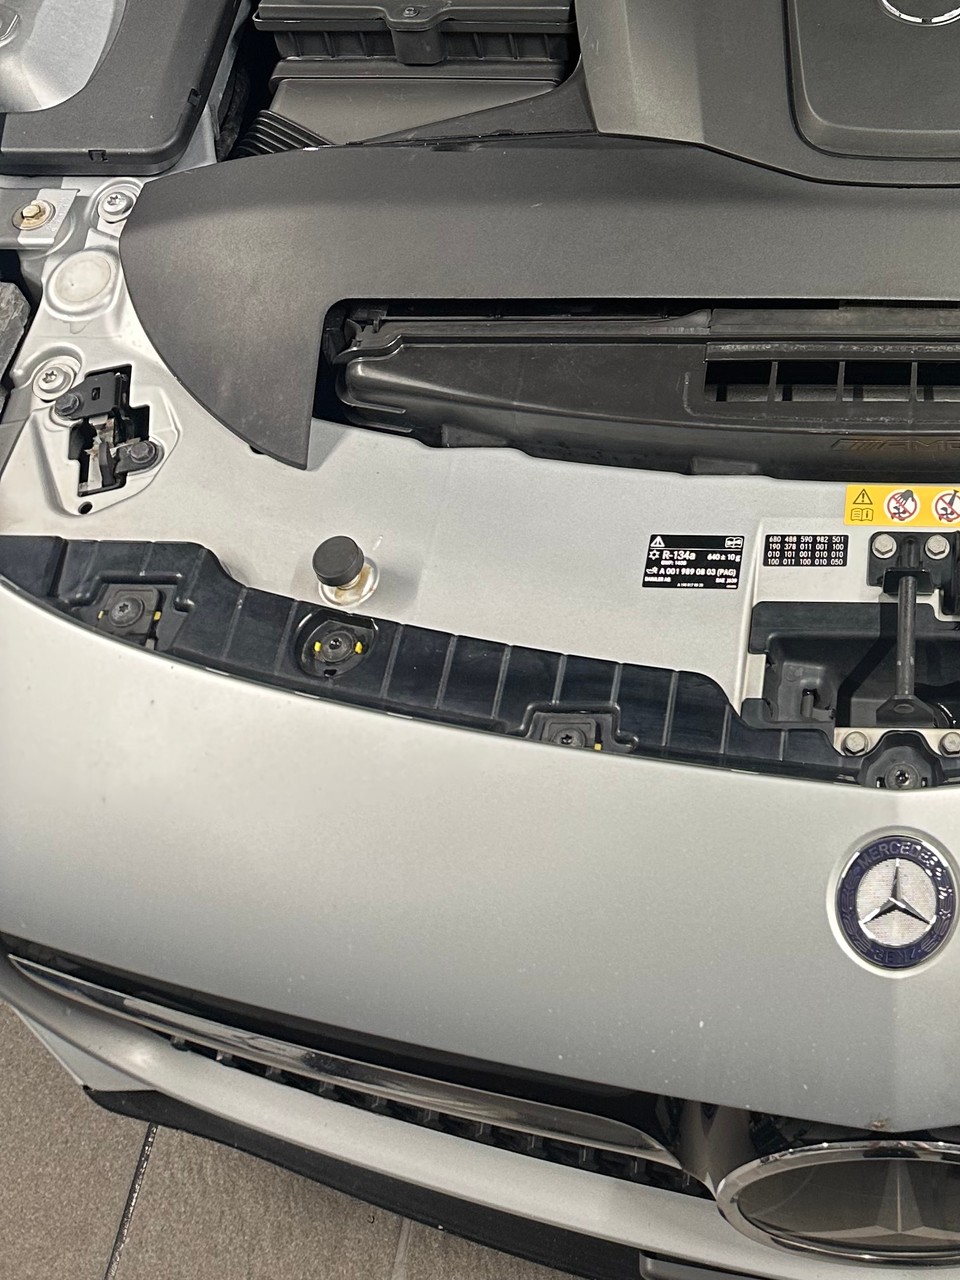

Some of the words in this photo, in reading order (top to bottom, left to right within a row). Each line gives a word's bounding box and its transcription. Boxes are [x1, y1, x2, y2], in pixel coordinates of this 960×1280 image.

[661, 550, 696, 560] R-134a
[706, 553, 720, 561] 640
[727, 553, 735, 561] 10
[659, 567, 665, 575] A
[666, 567, 680, 575] 001
[681, 567, 695, 576] 989
[706, 568, 716, 576] 03
[716, 568, 737, 578] (PAG)
